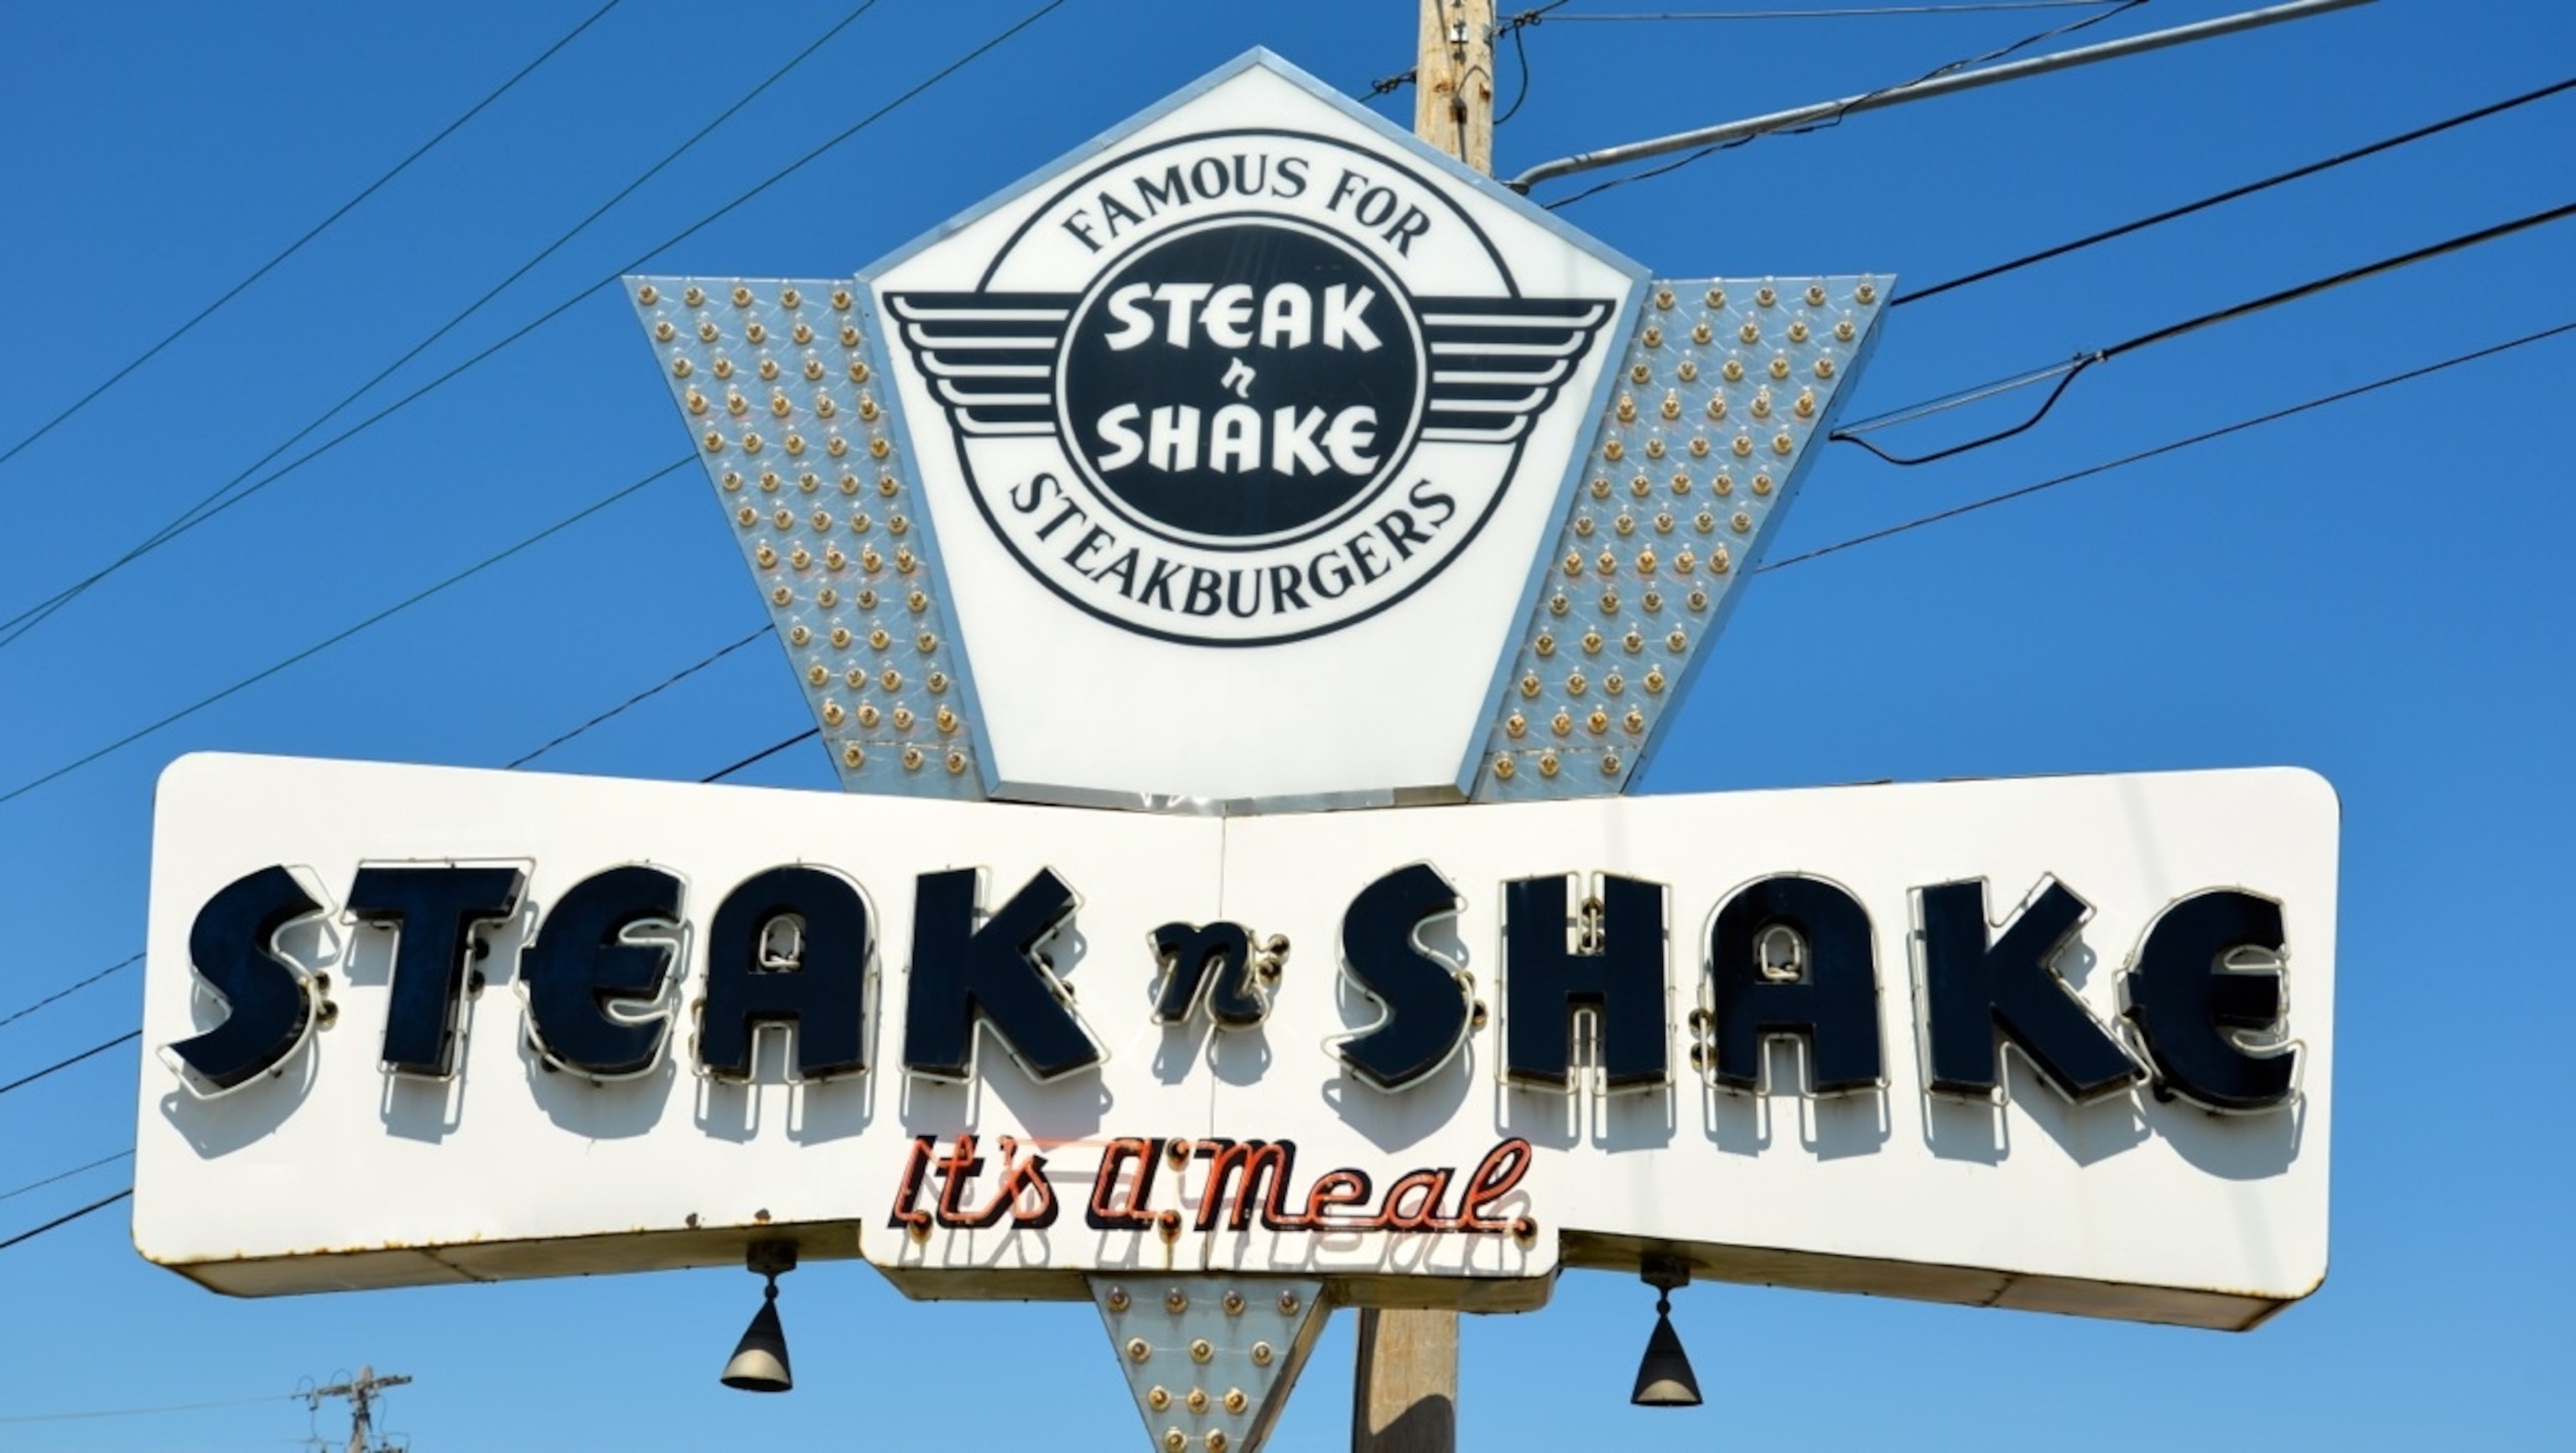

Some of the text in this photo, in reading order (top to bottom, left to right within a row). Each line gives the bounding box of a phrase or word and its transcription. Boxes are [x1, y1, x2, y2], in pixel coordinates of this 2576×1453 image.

[1062, 153, 1431, 258] FAMOUS FOR
[1104, 283, 1383, 352] STEAK
[1222, 358, 1256, 398] n
[1097, 403, 1379, 476] SHAKE
[1010, 471, 1457, 619] STEAKBURGERS
[167, 860, 2302, 1113] STEAK n SHAKE
[886, 1134, 1058, 1230] It's
[1193, 1137, 1535, 1232] Meal
